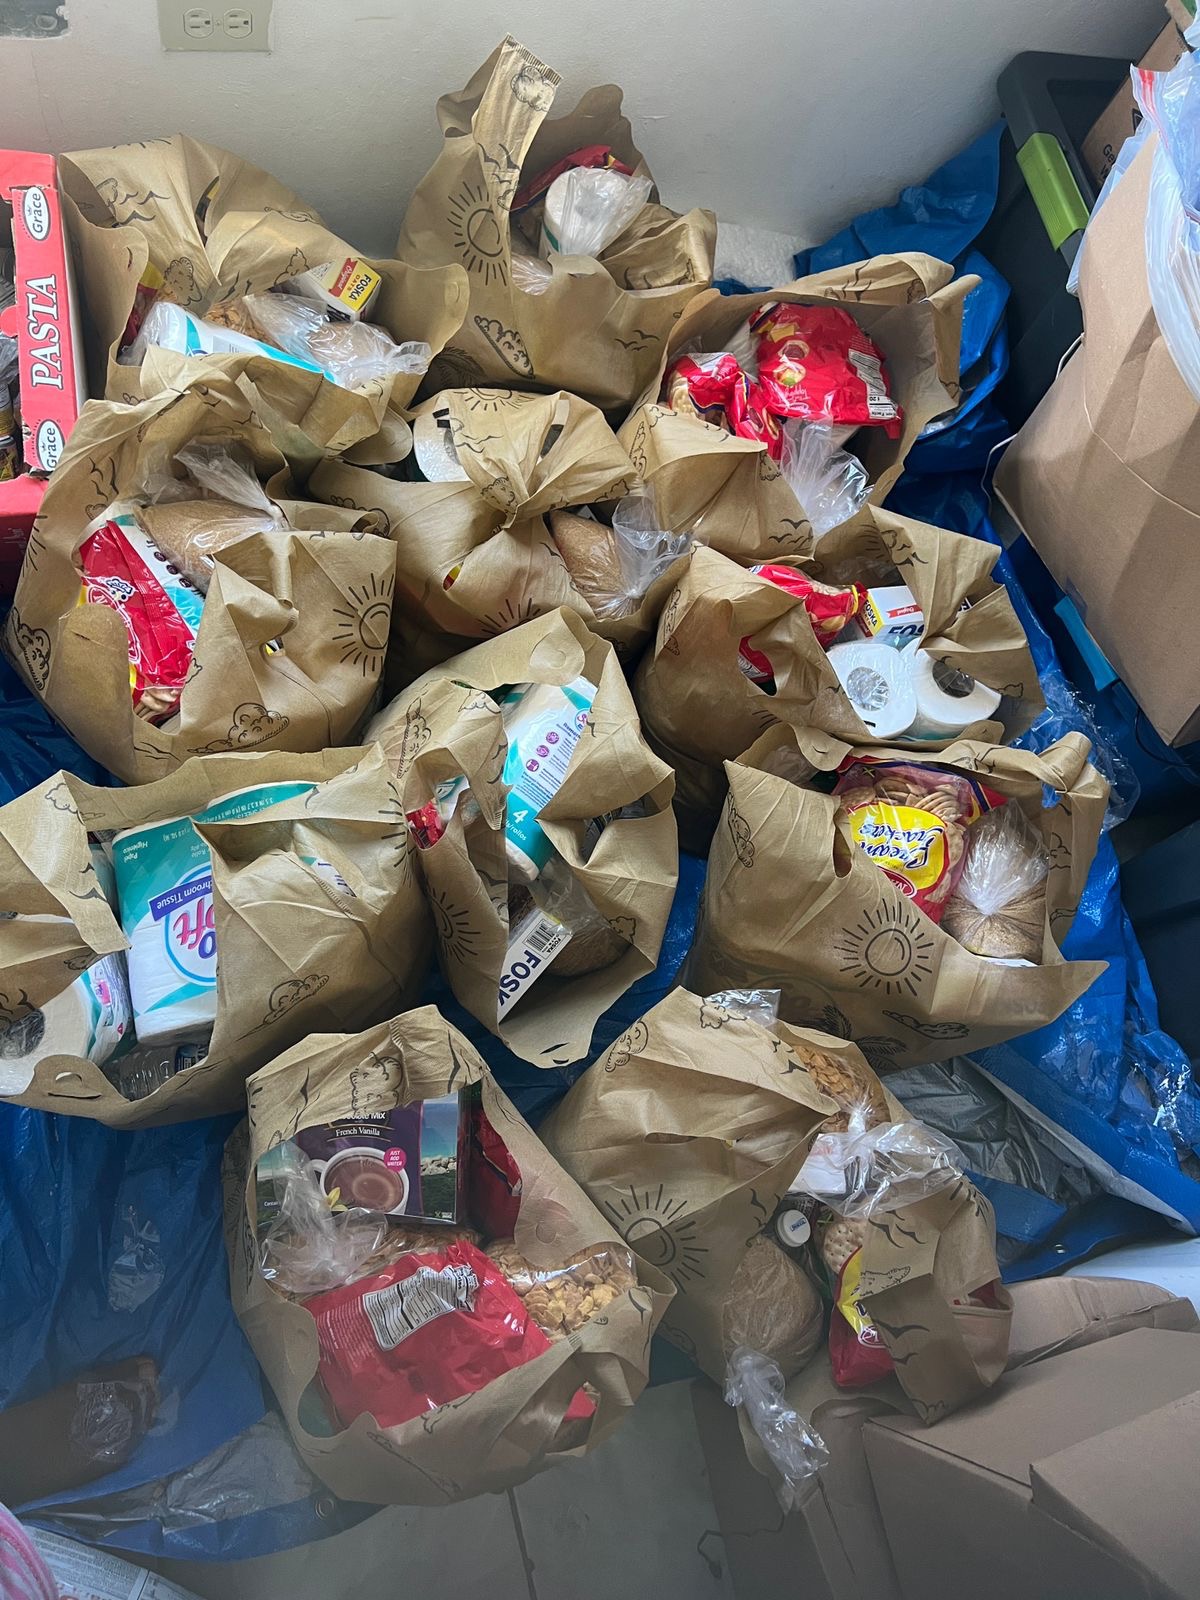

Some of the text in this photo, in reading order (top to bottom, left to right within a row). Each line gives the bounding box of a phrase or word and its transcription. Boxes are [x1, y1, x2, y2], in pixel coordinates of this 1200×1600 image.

[31, 192, 43, 235] Grace
[348, 273, 373, 301] FOSKA
[25, 274, 65, 391] PASTA
[46, 427, 58, 469] Grace
[512, 809, 529, 824] 4
[859, 823, 945, 848] Crackers
[860, 841, 929, 869] Cream
[156, 892, 184, 910] Tissue
[335, 1126, 380, 1137] French Vanilla
